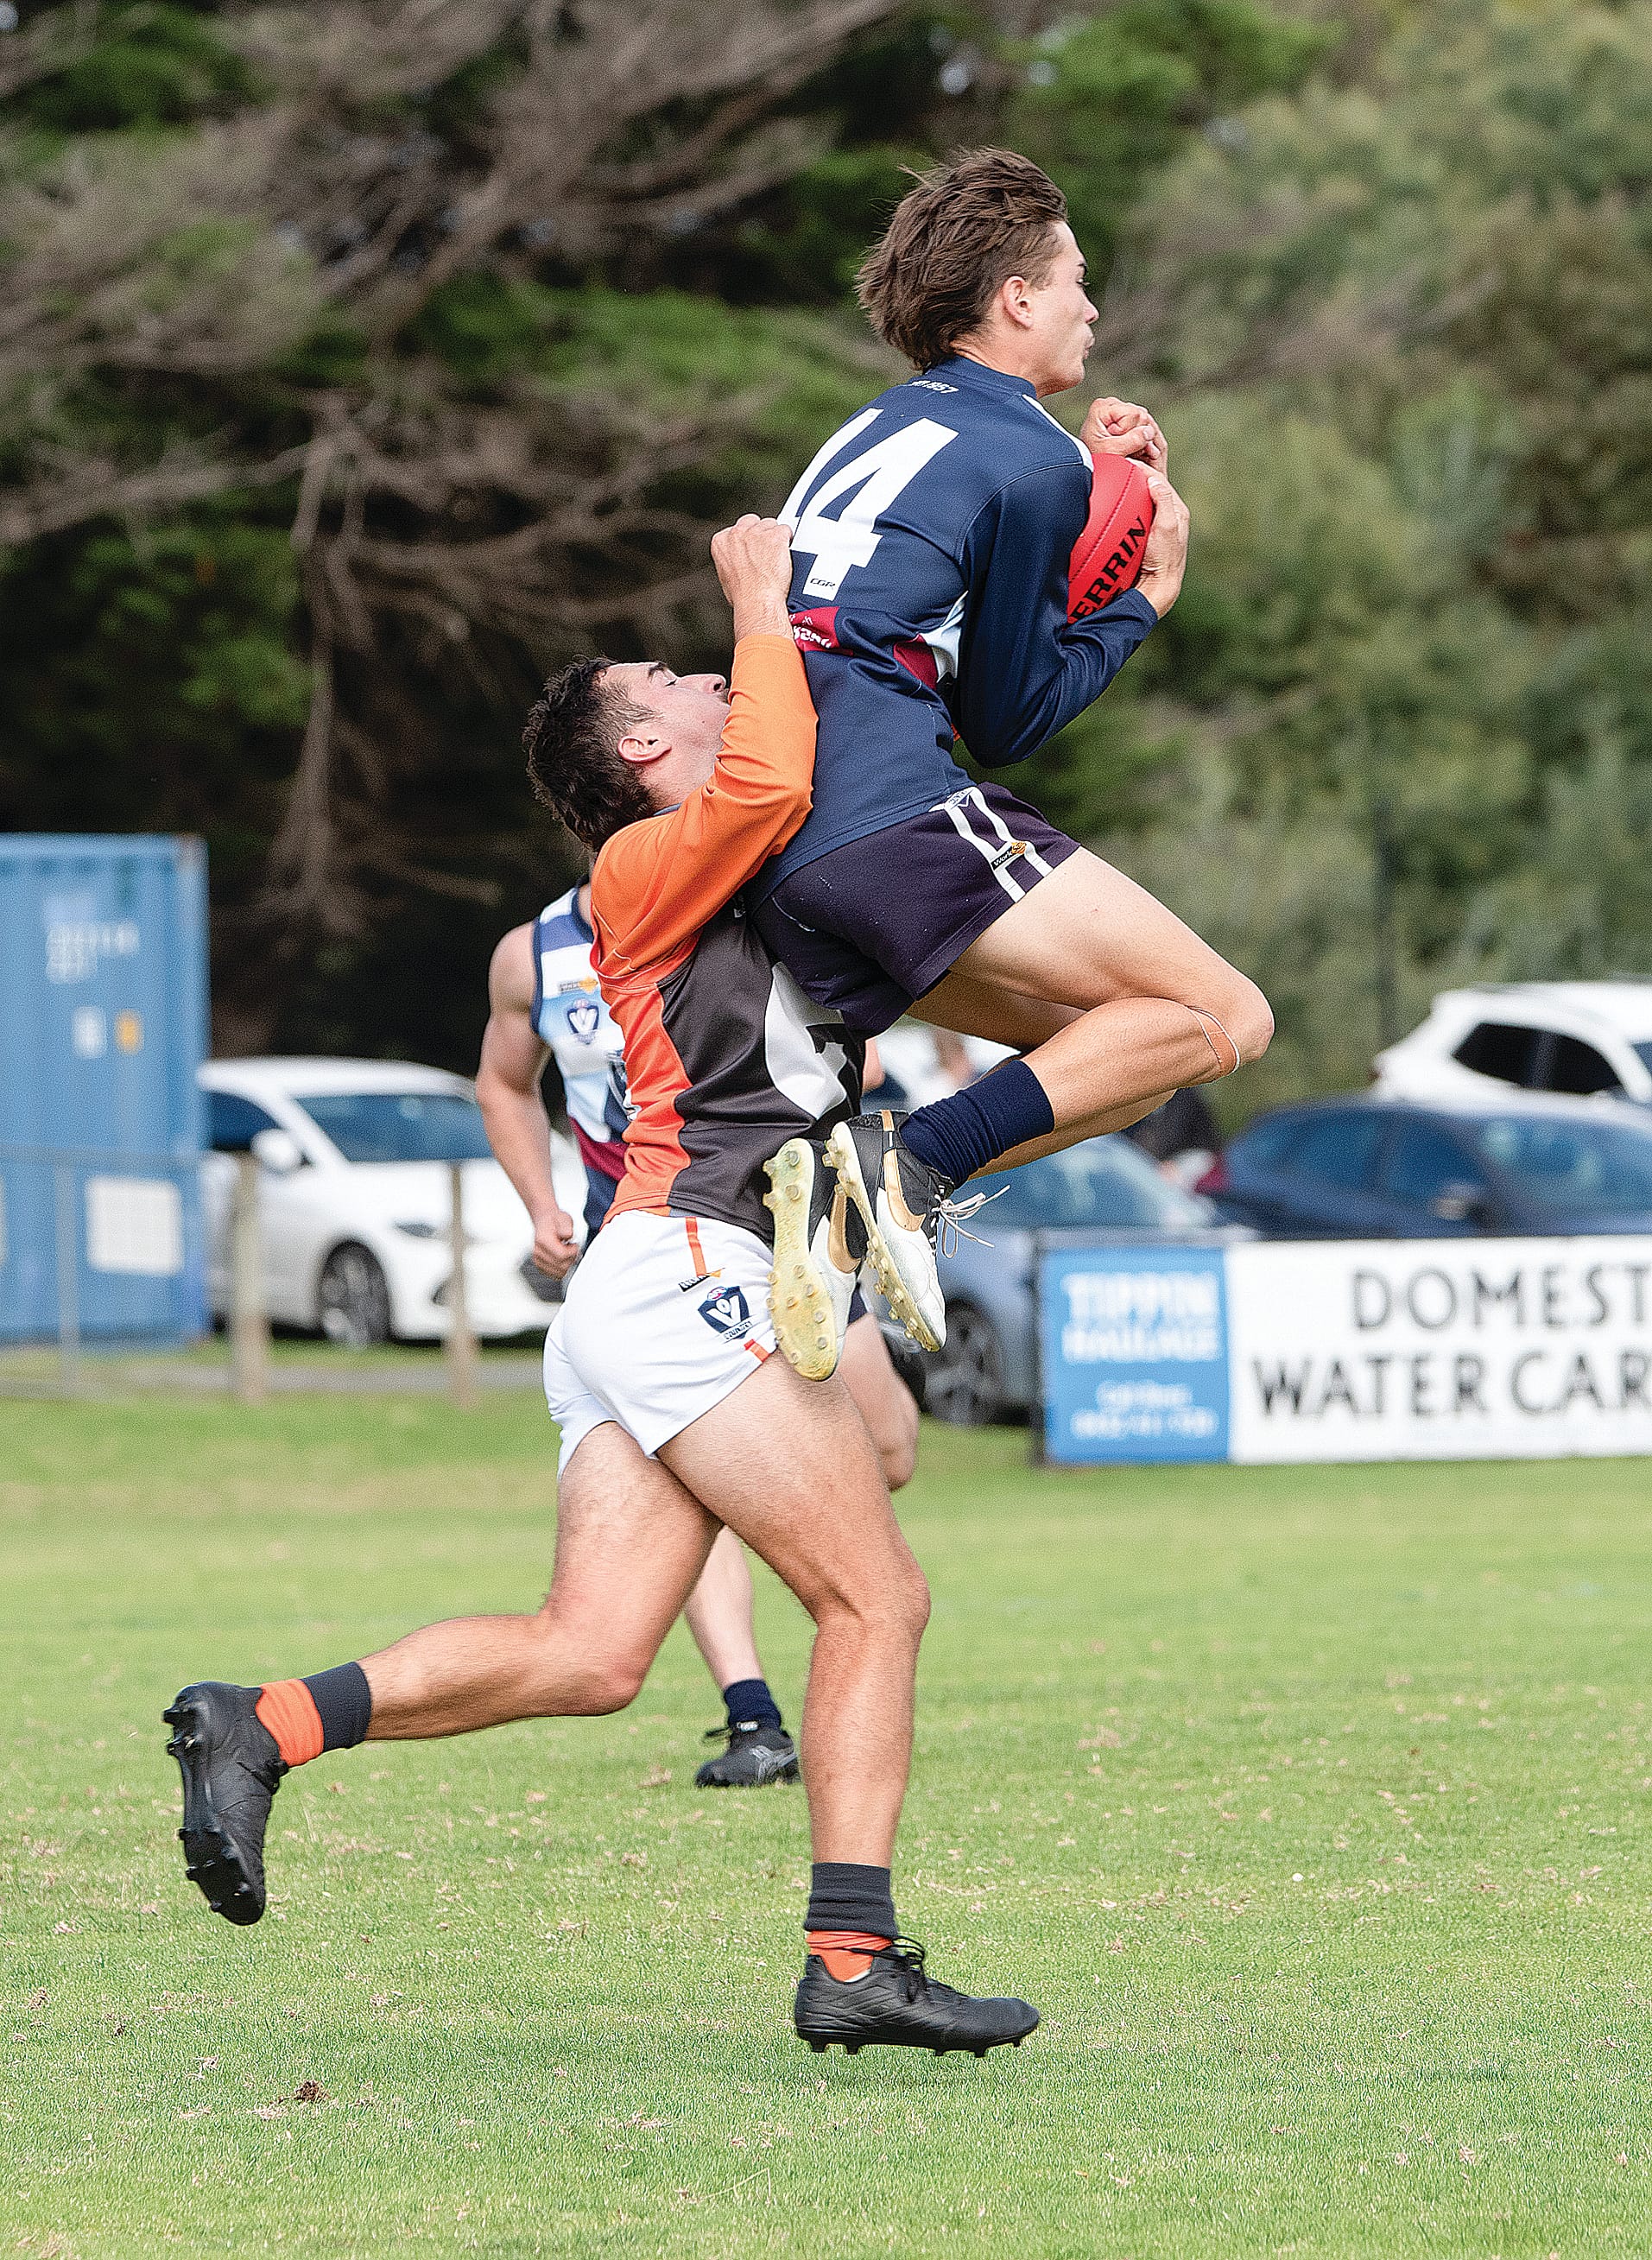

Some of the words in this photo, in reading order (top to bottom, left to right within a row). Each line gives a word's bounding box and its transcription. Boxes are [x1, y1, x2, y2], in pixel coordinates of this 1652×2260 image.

[777, 408, 959, 602] 14
[1354, 1263, 1652, 1330] DOMEST
[1252, 1349, 1484, 1418] WATER
[1512, 1349, 1652, 1417] CAR
